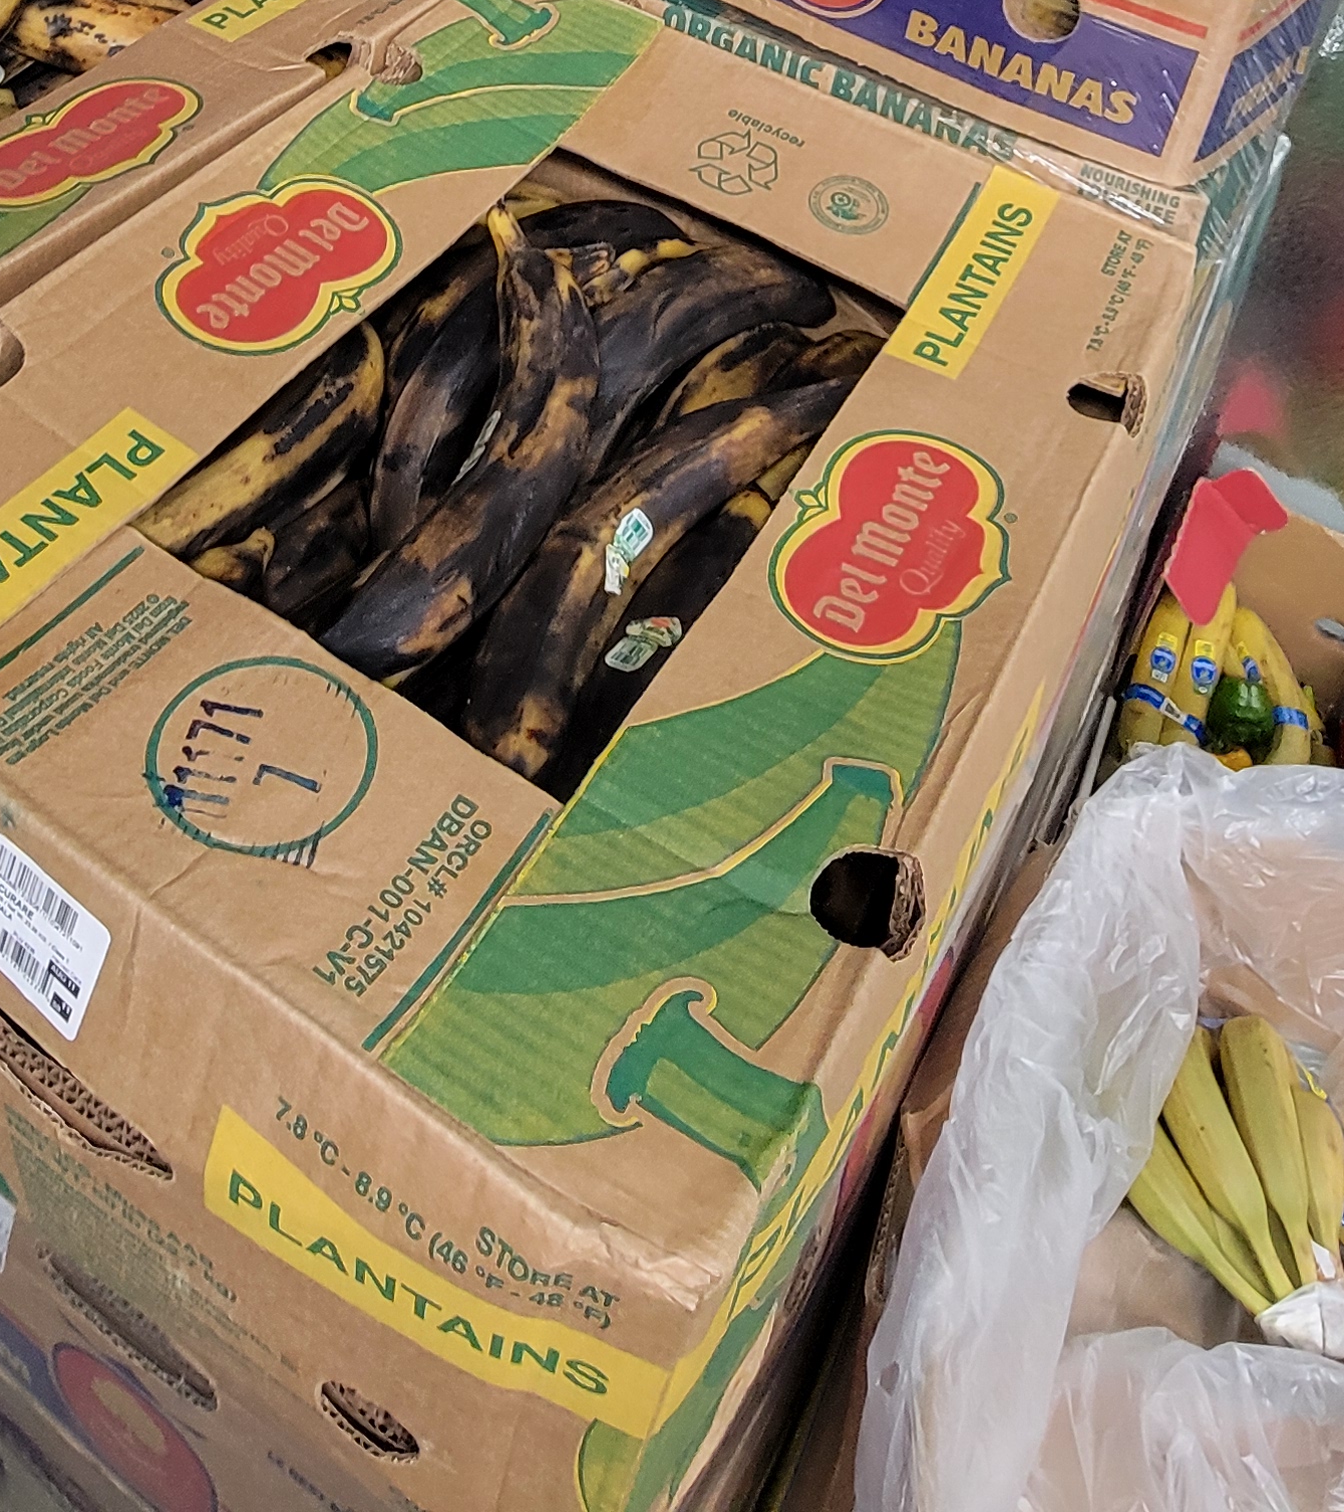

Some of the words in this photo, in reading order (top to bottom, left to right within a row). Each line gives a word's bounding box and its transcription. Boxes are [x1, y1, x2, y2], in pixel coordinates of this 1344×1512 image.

[663, 4, 824, 91] ORGANIC
[830, 68, 1017, 164] BANANAS
[904, 9, 1139, 125] BANANAS
[48, 88, 169, 154] Monte
[727, 108, 806, 148] recyclable
[1080, 164, 1180, 209] NOURISHING
[212, 214, 288, 265] Quality
[298, 202, 369, 251] Del
[1100, 242, 1127, 277] STORE
[1116, 229, 1133, 246] AT
[197, 239, 320, 329] Monte
[911, 200, 1035, 368] PLANTAINS
[813, 563, 887, 632] Del
[854, 450, 952, 565] Monte
[900, 518, 966, 595] Quality
[83, 621, 104, 641] All
[130, 615, 154, 636] Del
[65, 658, 104, 689] Foods
[313, 794, 478, 985] DBAN-001-C-V1
[427, 819, 492, 899] ORCL#
[47, 962, 71, 984] AUG
[344, 899, 431, 997] 10421575
[275, 1095, 308, 1141] 7.8
[313, 1130, 340, 1167] °C
[354, 1170, 393, 1213] 8.9
[397, 1202, 426, 1241] °C
[428, 1231, 468, 1275] (46
[528, 1283, 565, 1308] 48
[572, 1300, 611, 1331] °F)
[225, 1166, 611, 1396] PLANTAINS
[475, 1226, 574, 1290] STORE
[578, 1285, 621, 1308] AT
